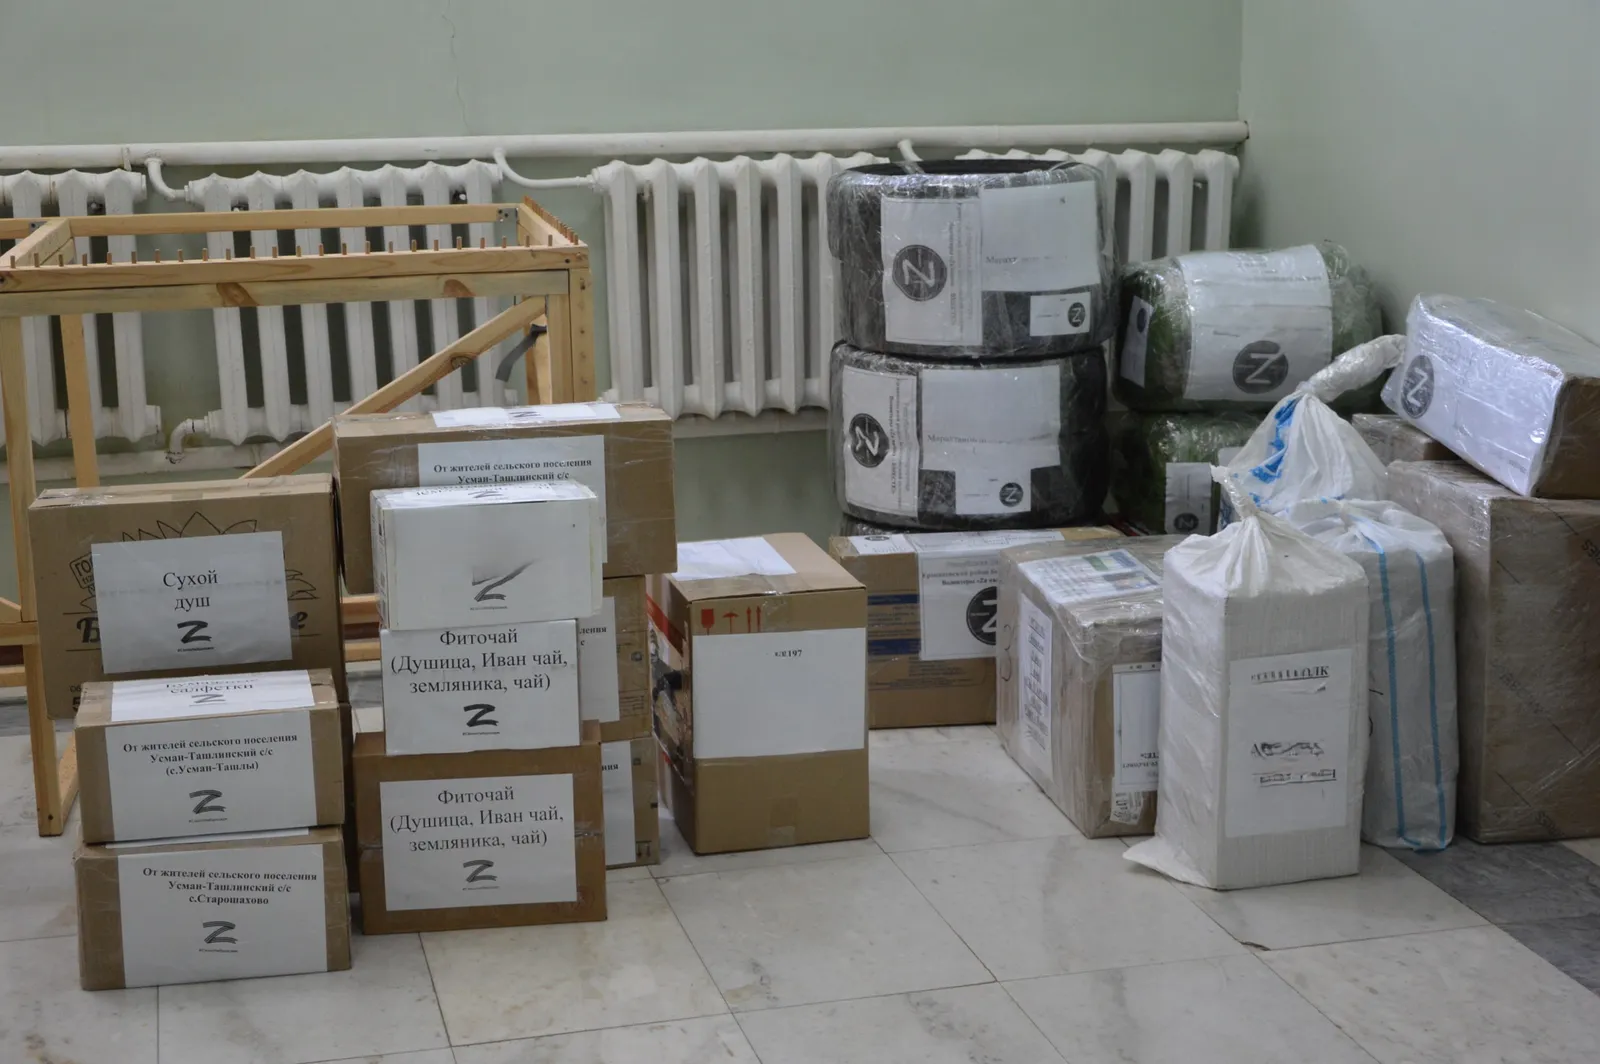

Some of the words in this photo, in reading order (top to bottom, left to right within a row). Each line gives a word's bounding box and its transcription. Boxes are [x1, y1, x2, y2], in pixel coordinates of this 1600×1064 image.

[433, 464, 447, 473] От
[449, 462, 491, 473] жителей
[493, 462, 541, 471] сельского
[543, 459, 592, 468] поселения
[455, 471, 555, 486] Усман-Ташлинский
[556, 471, 570, 480] с/с
[162, 569, 218, 591] Сухой
[174, 596, 211, 613] душ
[177, 620, 212, 644] Z
[439, 628, 518, 646] Фиточай
[390, 655, 476, 675] (Душица,
[482, 652, 527, 668] Иван
[532, 649, 568, 667] чай,
[409, 679, 508, 694] земляника,
[513, 673, 551, 691] чай)
[463, 703, 499, 727] Z
[123, 743, 137, 753] От
[141, 740, 186, 752] жителей
[188, 738, 241, 748] сельского
[243, 734, 298, 745] поселения
[150, 746, 259, 766] Усман-Ташлинский
[259, 747, 273, 757] с/с
[165, 759, 259, 777] (с.Усман-Ташлы)
[189, 789, 226, 814] Z
[437, 786, 514, 805] Фиточай
[389, 814, 474, 834] (Душица,
[479, 809, 523, 825] Иван
[529, 805, 564, 822] чай,
[409, 836, 506, 852] земляника,
[511, 829, 548, 846] чай)
[142, 867, 157, 877] От
[160, 869, 206, 879] жителей
[208, 871, 261, 880] сельского
[263, 873, 317, 881] поселения
[463, 859, 497, 882] Z
[168, 880, 275, 893] Усман-Ташлинский
[277, 884, 292, 893] с/с
[188, 893, 269, 906] с.Старошахово
[202, 920, 238, 944] Z
